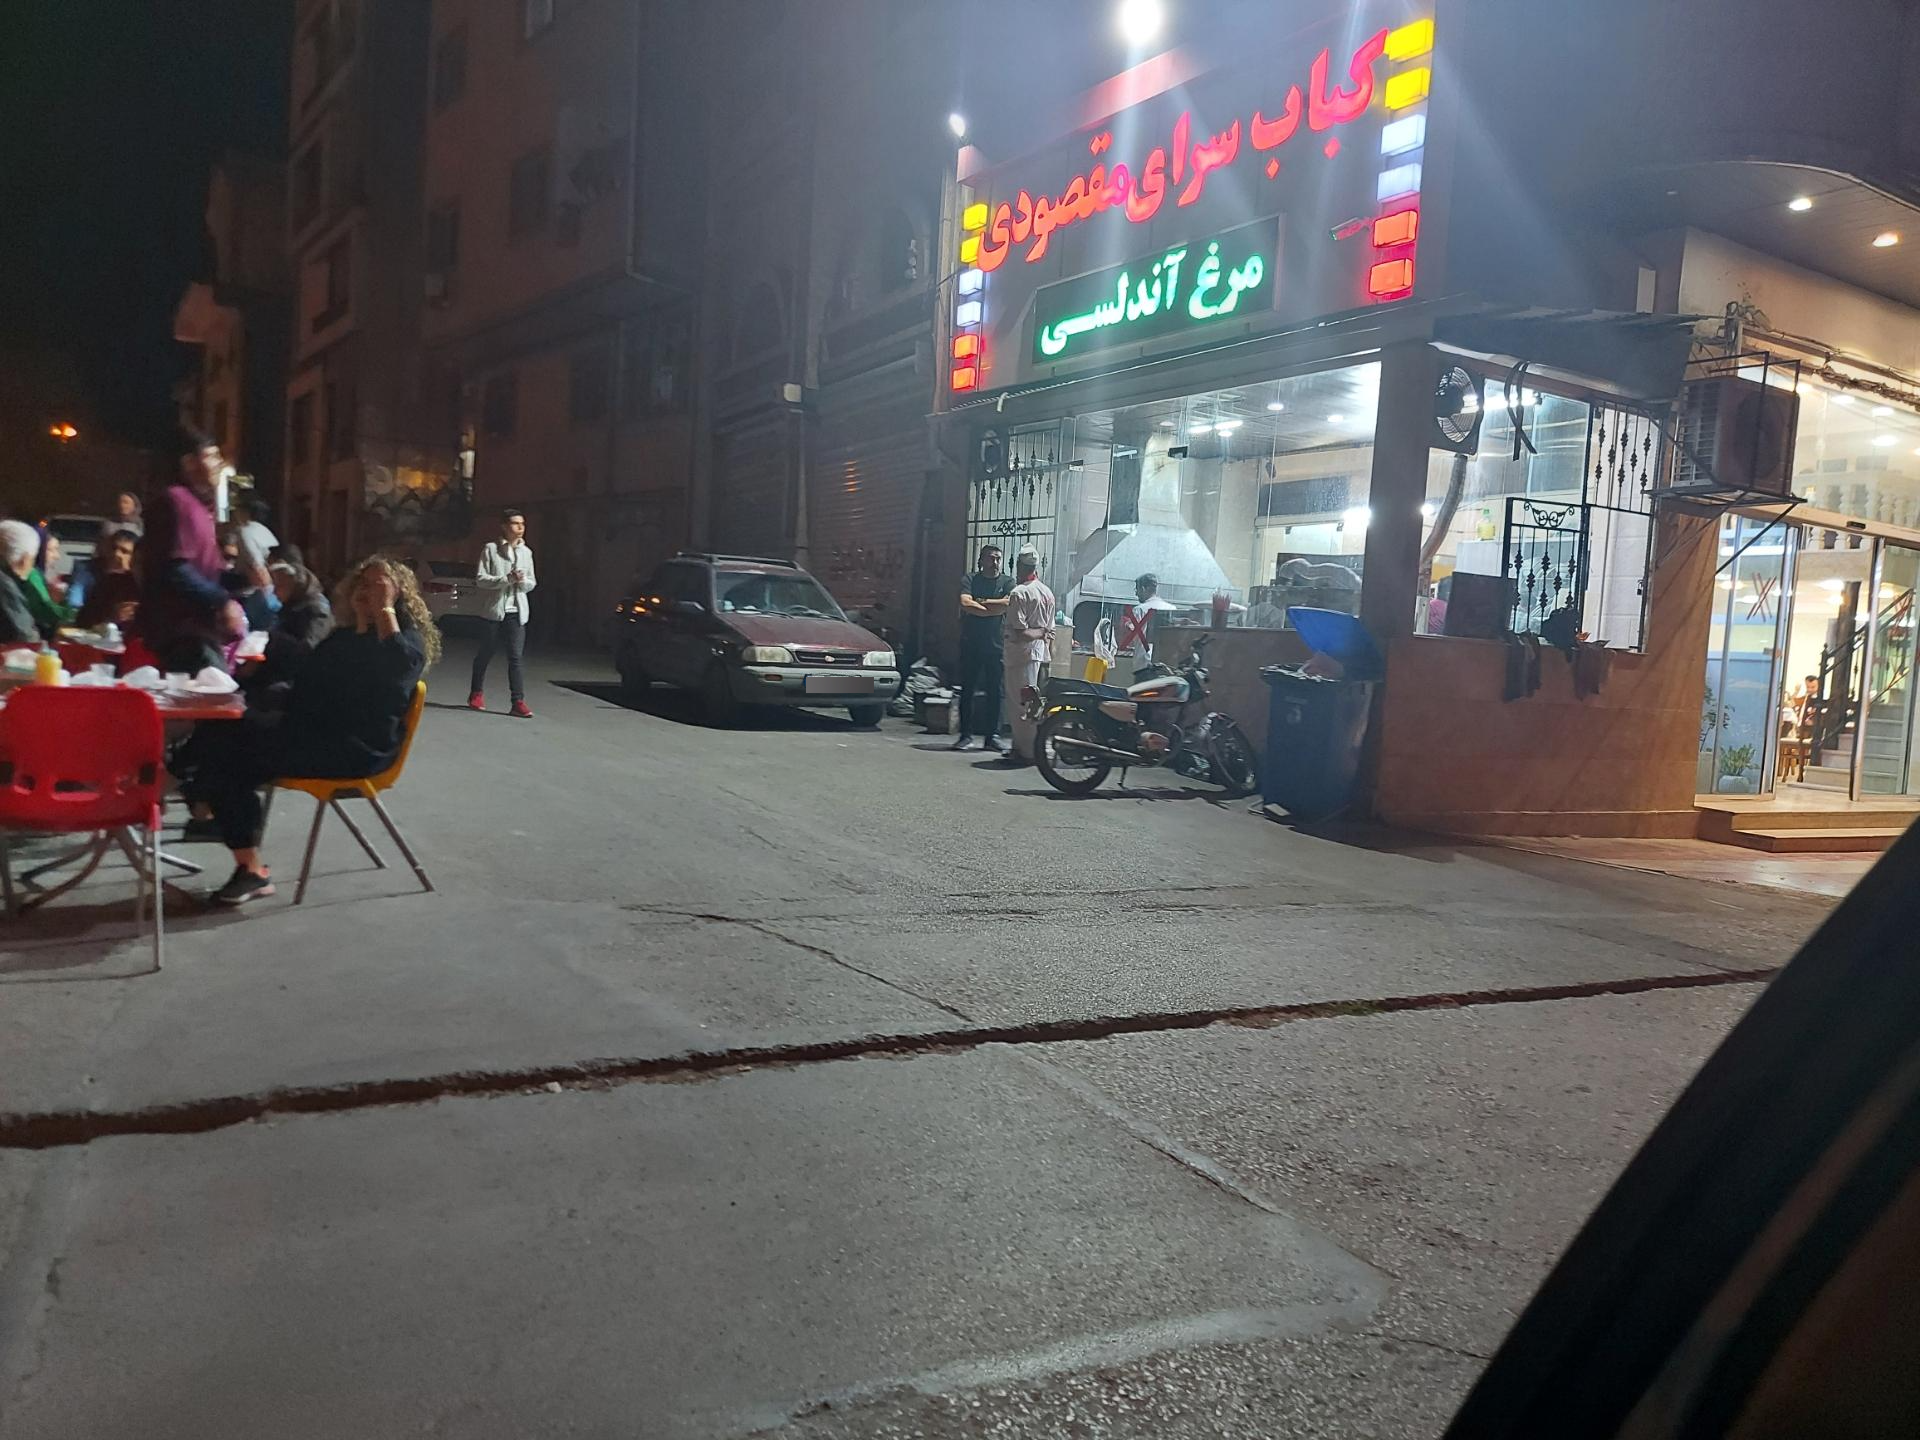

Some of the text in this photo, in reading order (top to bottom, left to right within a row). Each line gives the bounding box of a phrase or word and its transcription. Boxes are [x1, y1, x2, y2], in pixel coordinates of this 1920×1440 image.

[977, 28, 1389, 272] کباب سرای مقصودی
[1041, 242, 1264, 355] مرغ آندلسی
